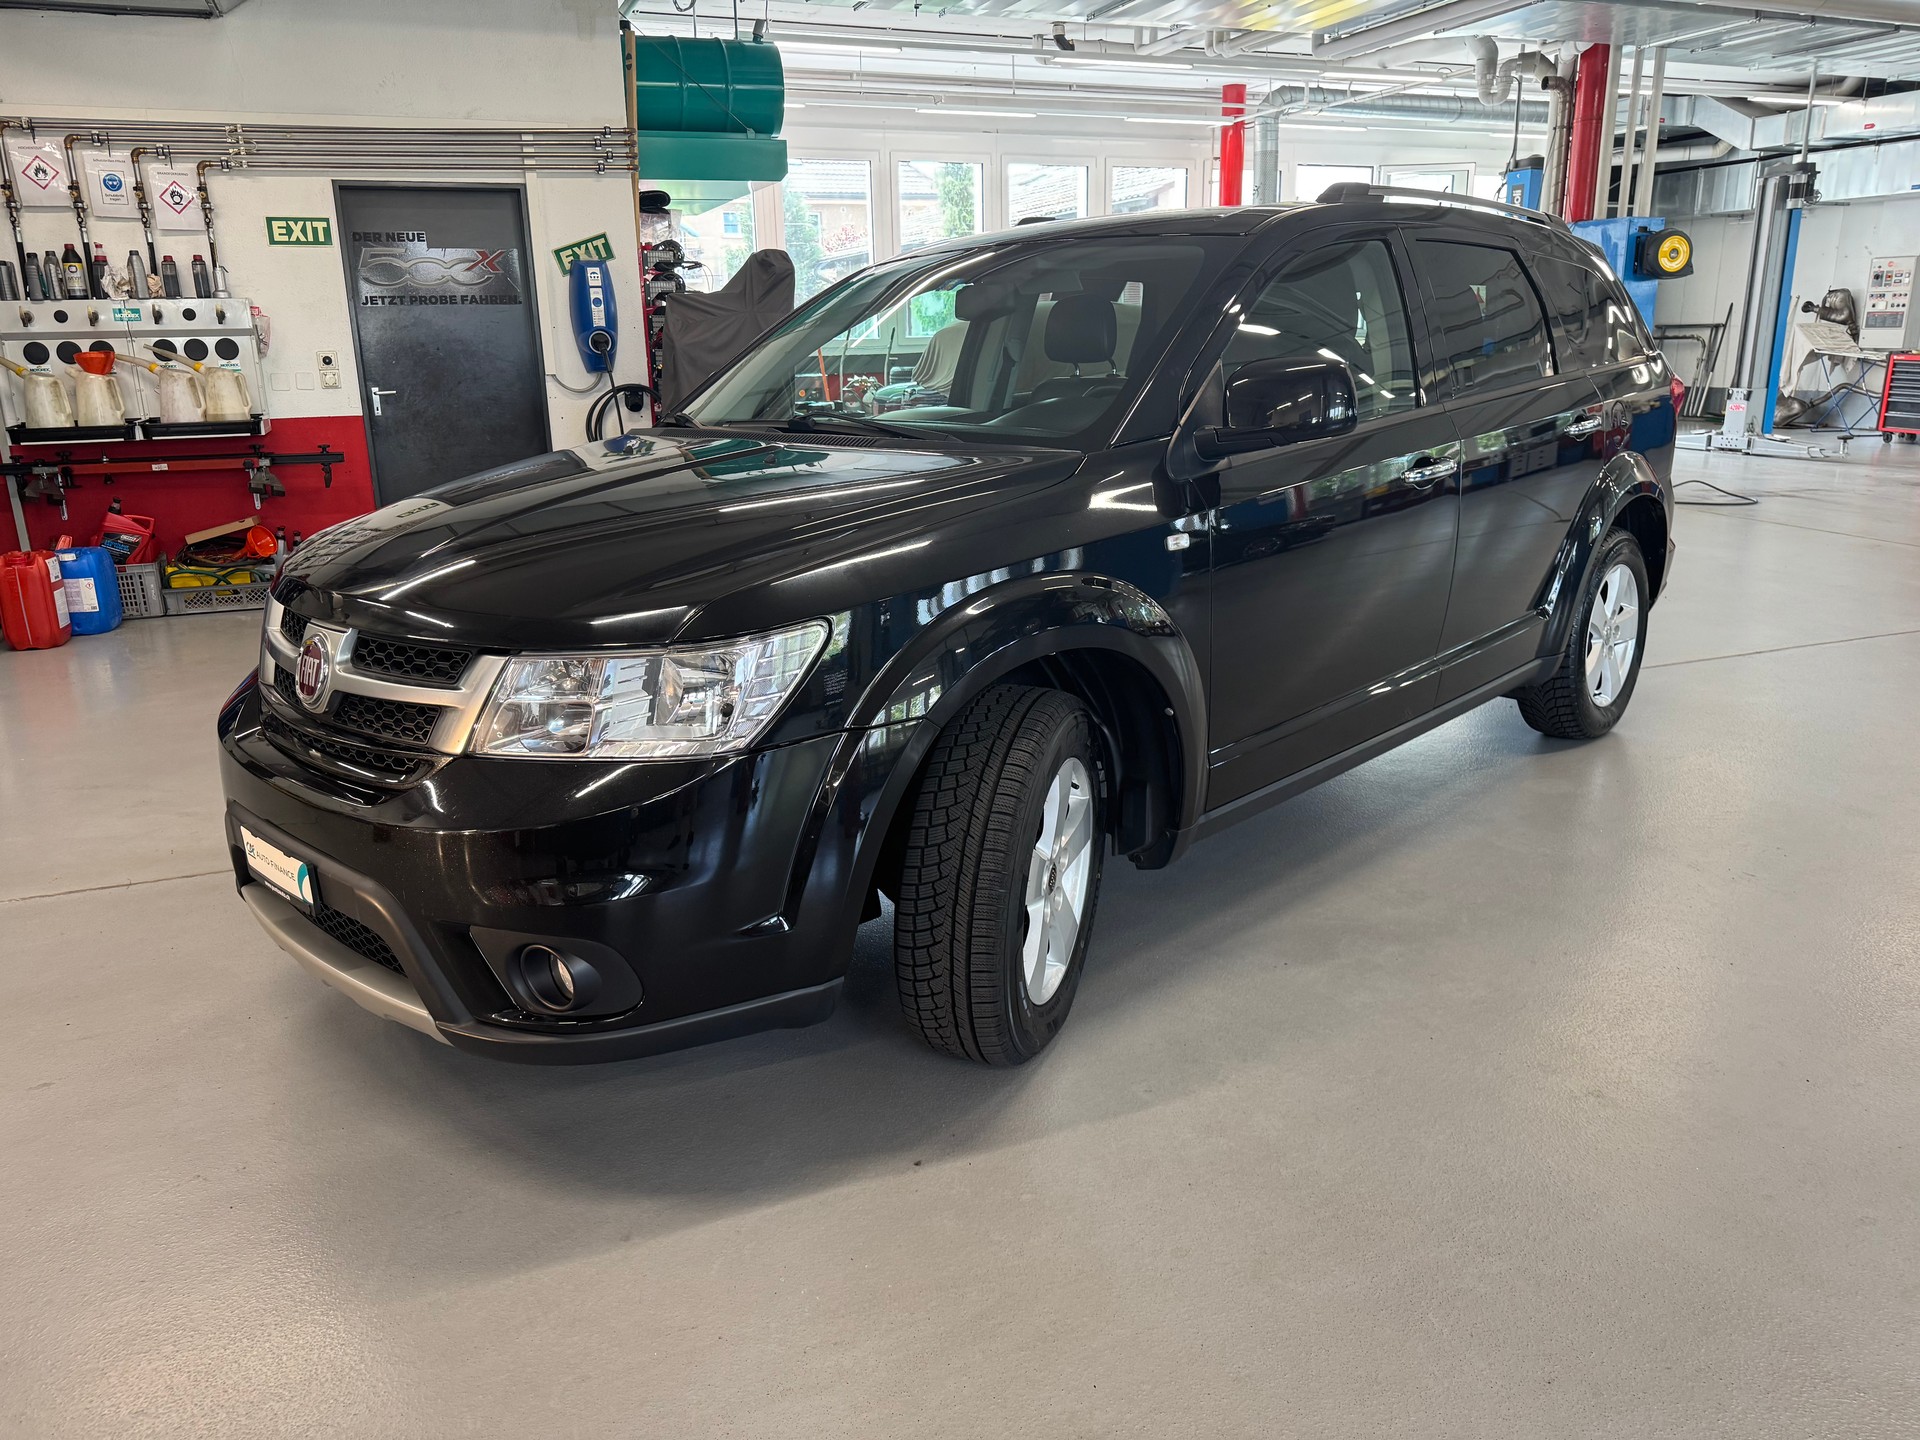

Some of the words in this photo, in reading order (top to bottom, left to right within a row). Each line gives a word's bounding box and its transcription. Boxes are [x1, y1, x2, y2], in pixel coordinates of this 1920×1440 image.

[271, 220, 328, 242] EXIT
[352, 232, 382, 243] DER
[385, 232, 426, 243] NEUE
[559, 237, 606, 271] EXIT
[361, 295, 406, 306] JETZT
[408, 295, 457, 306] PROBE
[300, 654, 320, 688] FIAT
[256, 850, 271, 866] AUTO
[270, 860, 296, 882] FINANCE
